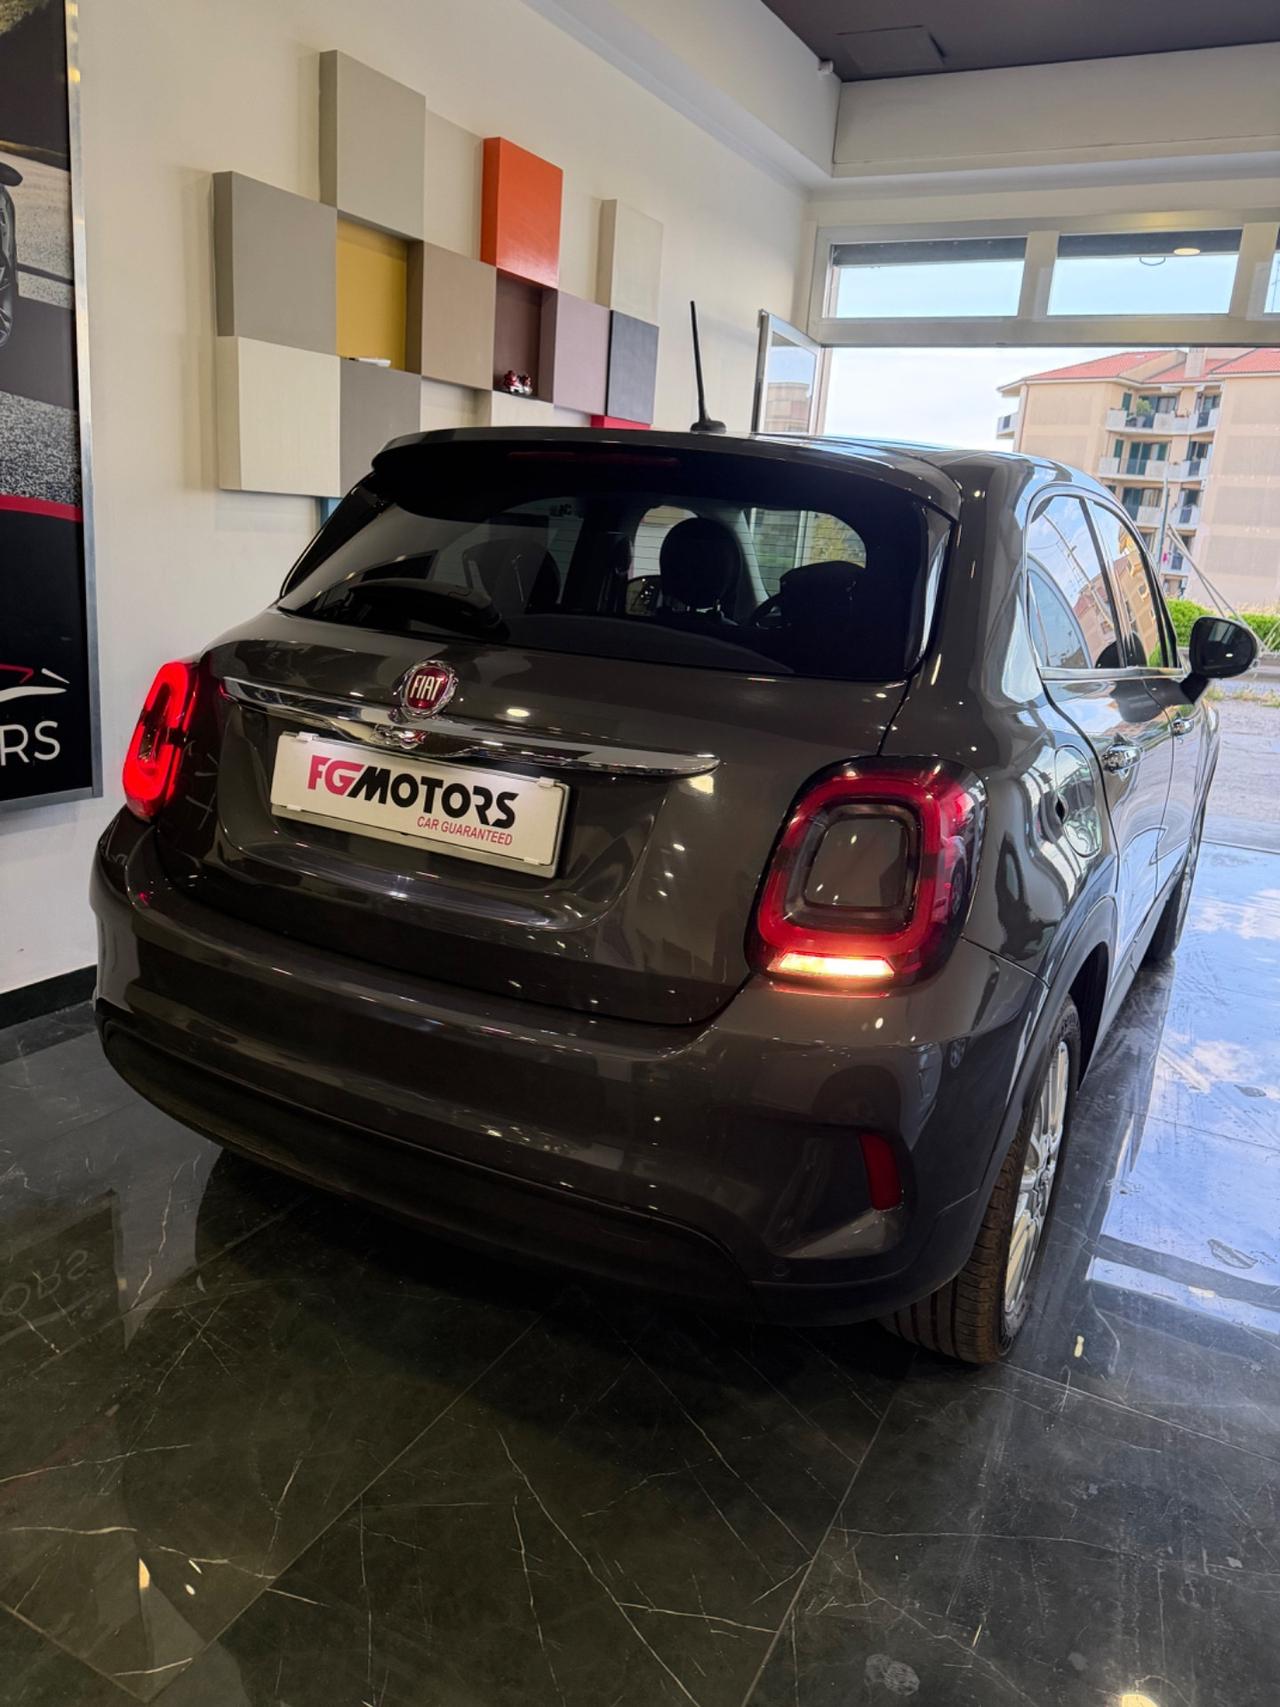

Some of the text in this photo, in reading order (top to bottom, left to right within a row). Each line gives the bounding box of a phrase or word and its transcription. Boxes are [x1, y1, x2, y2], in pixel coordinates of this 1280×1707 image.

[409, 675, 444, 701] FIAT
[417, 816, 513, 846] CAR GUARANTEED
